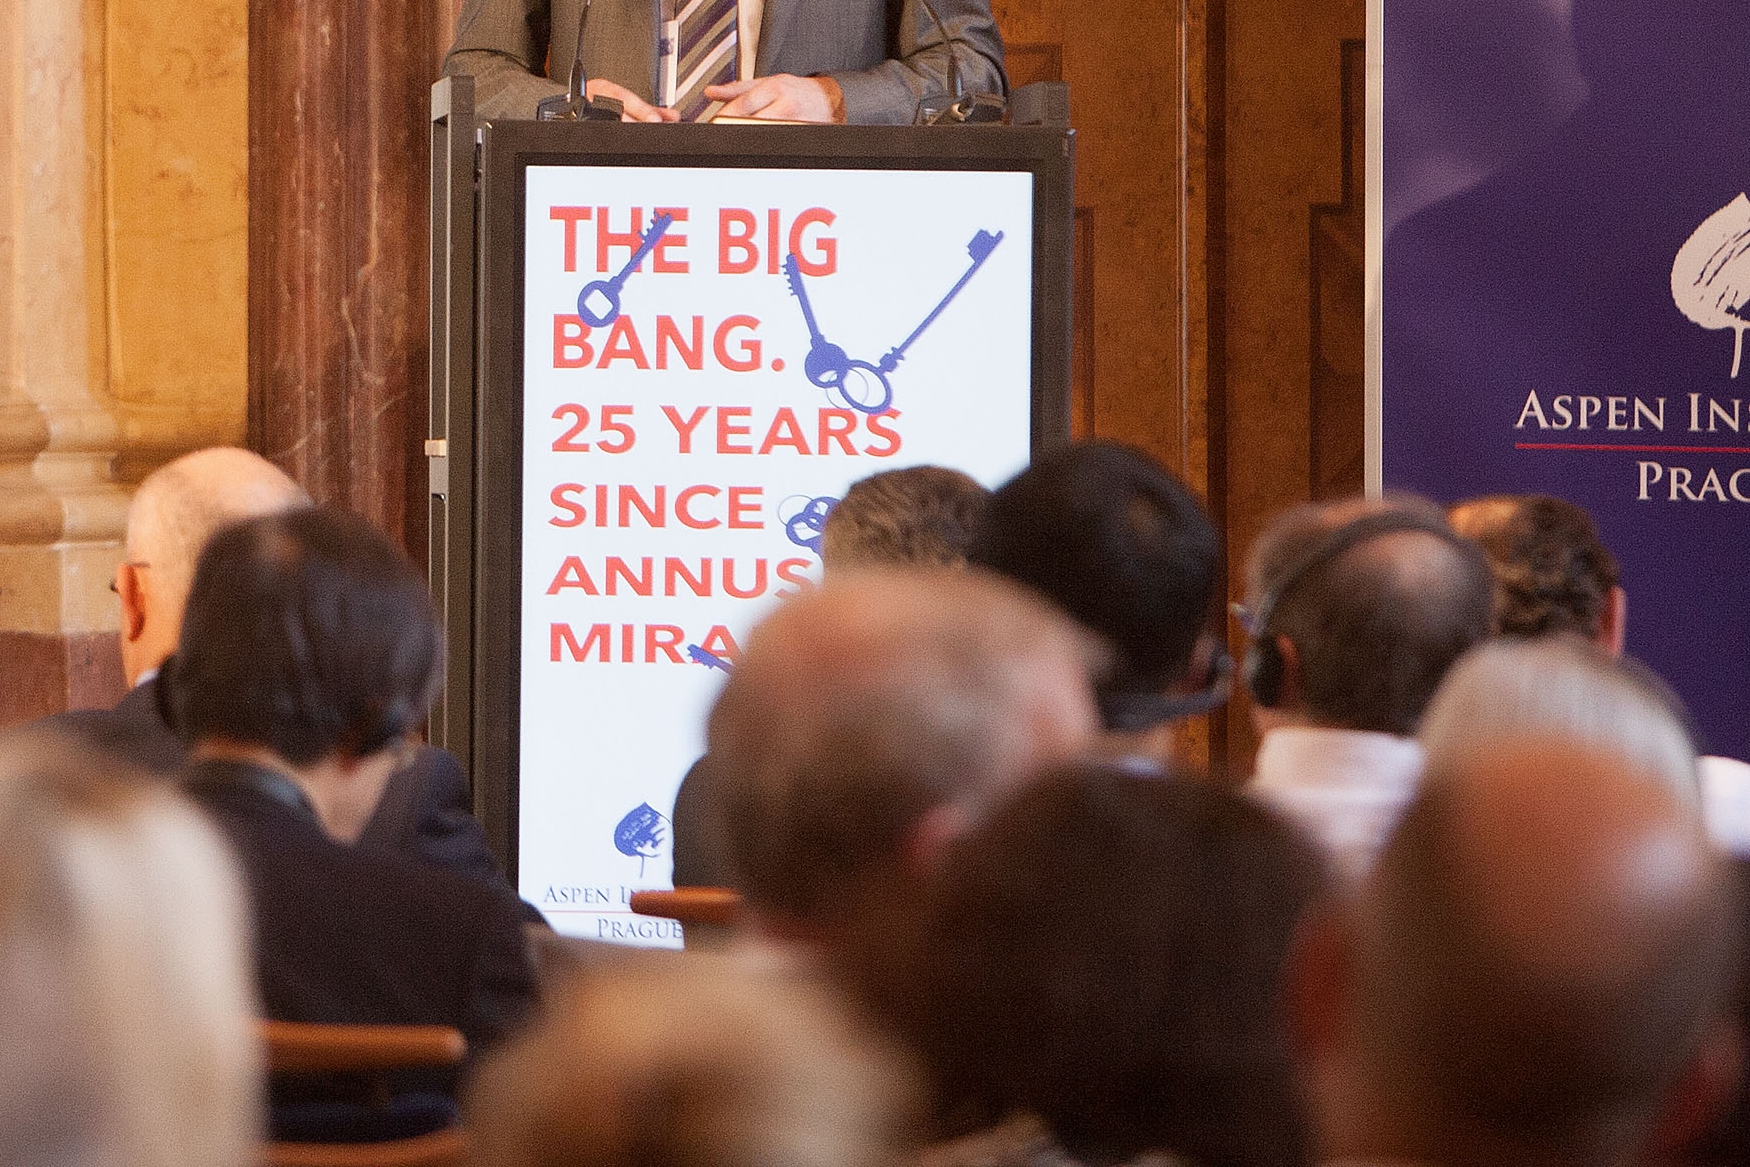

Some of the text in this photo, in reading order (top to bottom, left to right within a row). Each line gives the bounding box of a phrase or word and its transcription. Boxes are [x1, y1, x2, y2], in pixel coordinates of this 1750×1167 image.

[549, 206, 838, 277] THE BIG
[552, 313, 786, 373] BANG.
[551, 403, 903, 457] 25 YEARS
[1515, 389, 1750, 433] ASPEN IN
[548, 482, 765, 530] SINCE
[545, 556, 816, 599] ANNUS
[544, 885, 610, 904] ASPEN
[597, 918, 683, 939] PRAGUE
